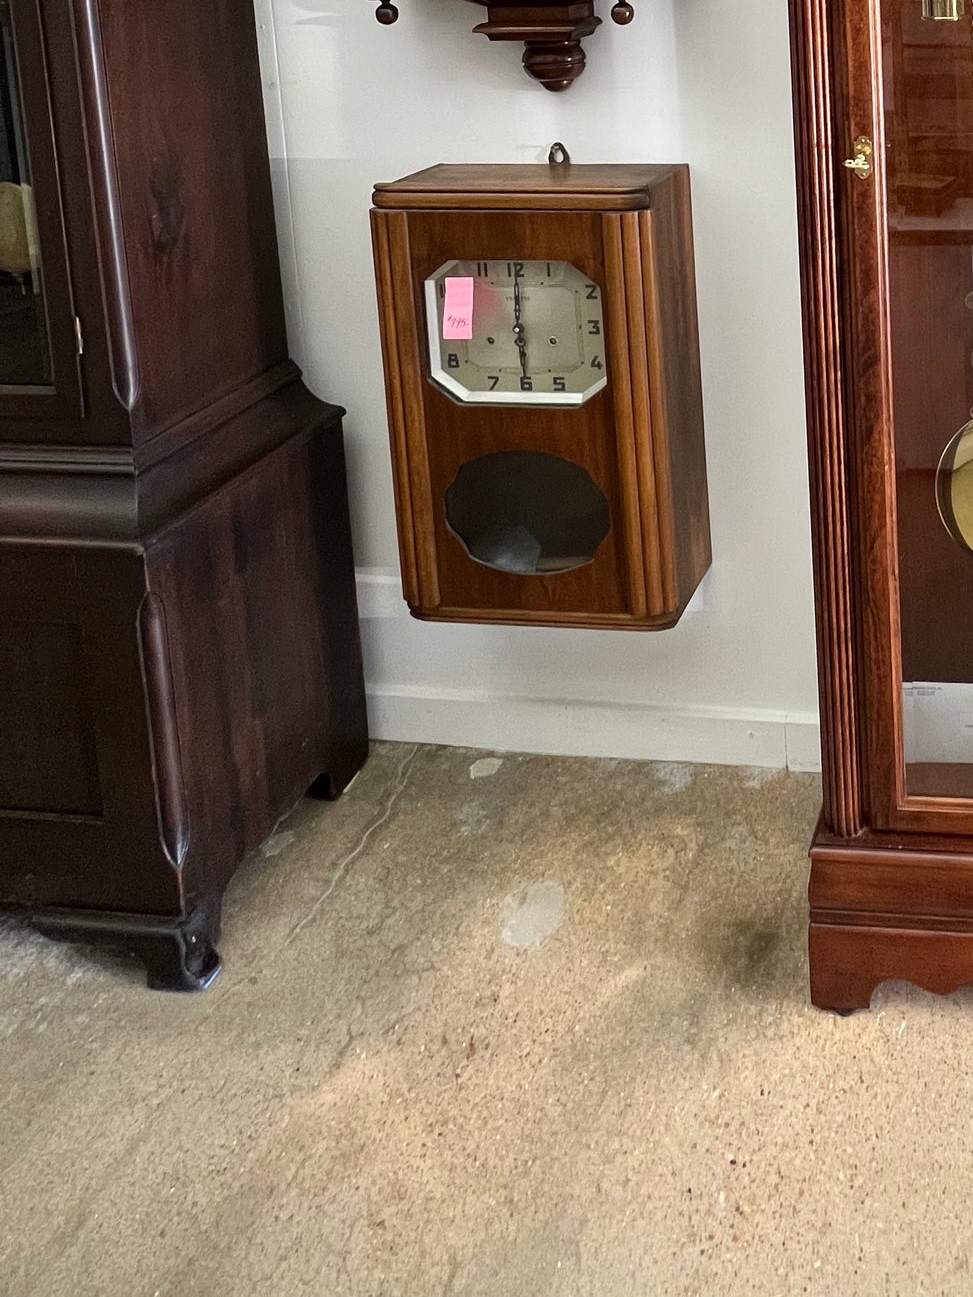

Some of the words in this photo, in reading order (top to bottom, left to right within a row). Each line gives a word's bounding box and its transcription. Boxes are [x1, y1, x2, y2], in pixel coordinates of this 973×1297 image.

[477, 263, 488, 278] 11
[507, 262, 525, 278] 12
[546, 263, 551, 278] 1
[585, 285, 598, 300] 2
[588, 320, 601, 335] 3
[447, 354, 460, 369] 8
[590, 355, 603, 370] 4
[487, 376, 500, 391] 7
[520, 376, 533, 392] 6
[553, 377, 566, 392] 5
